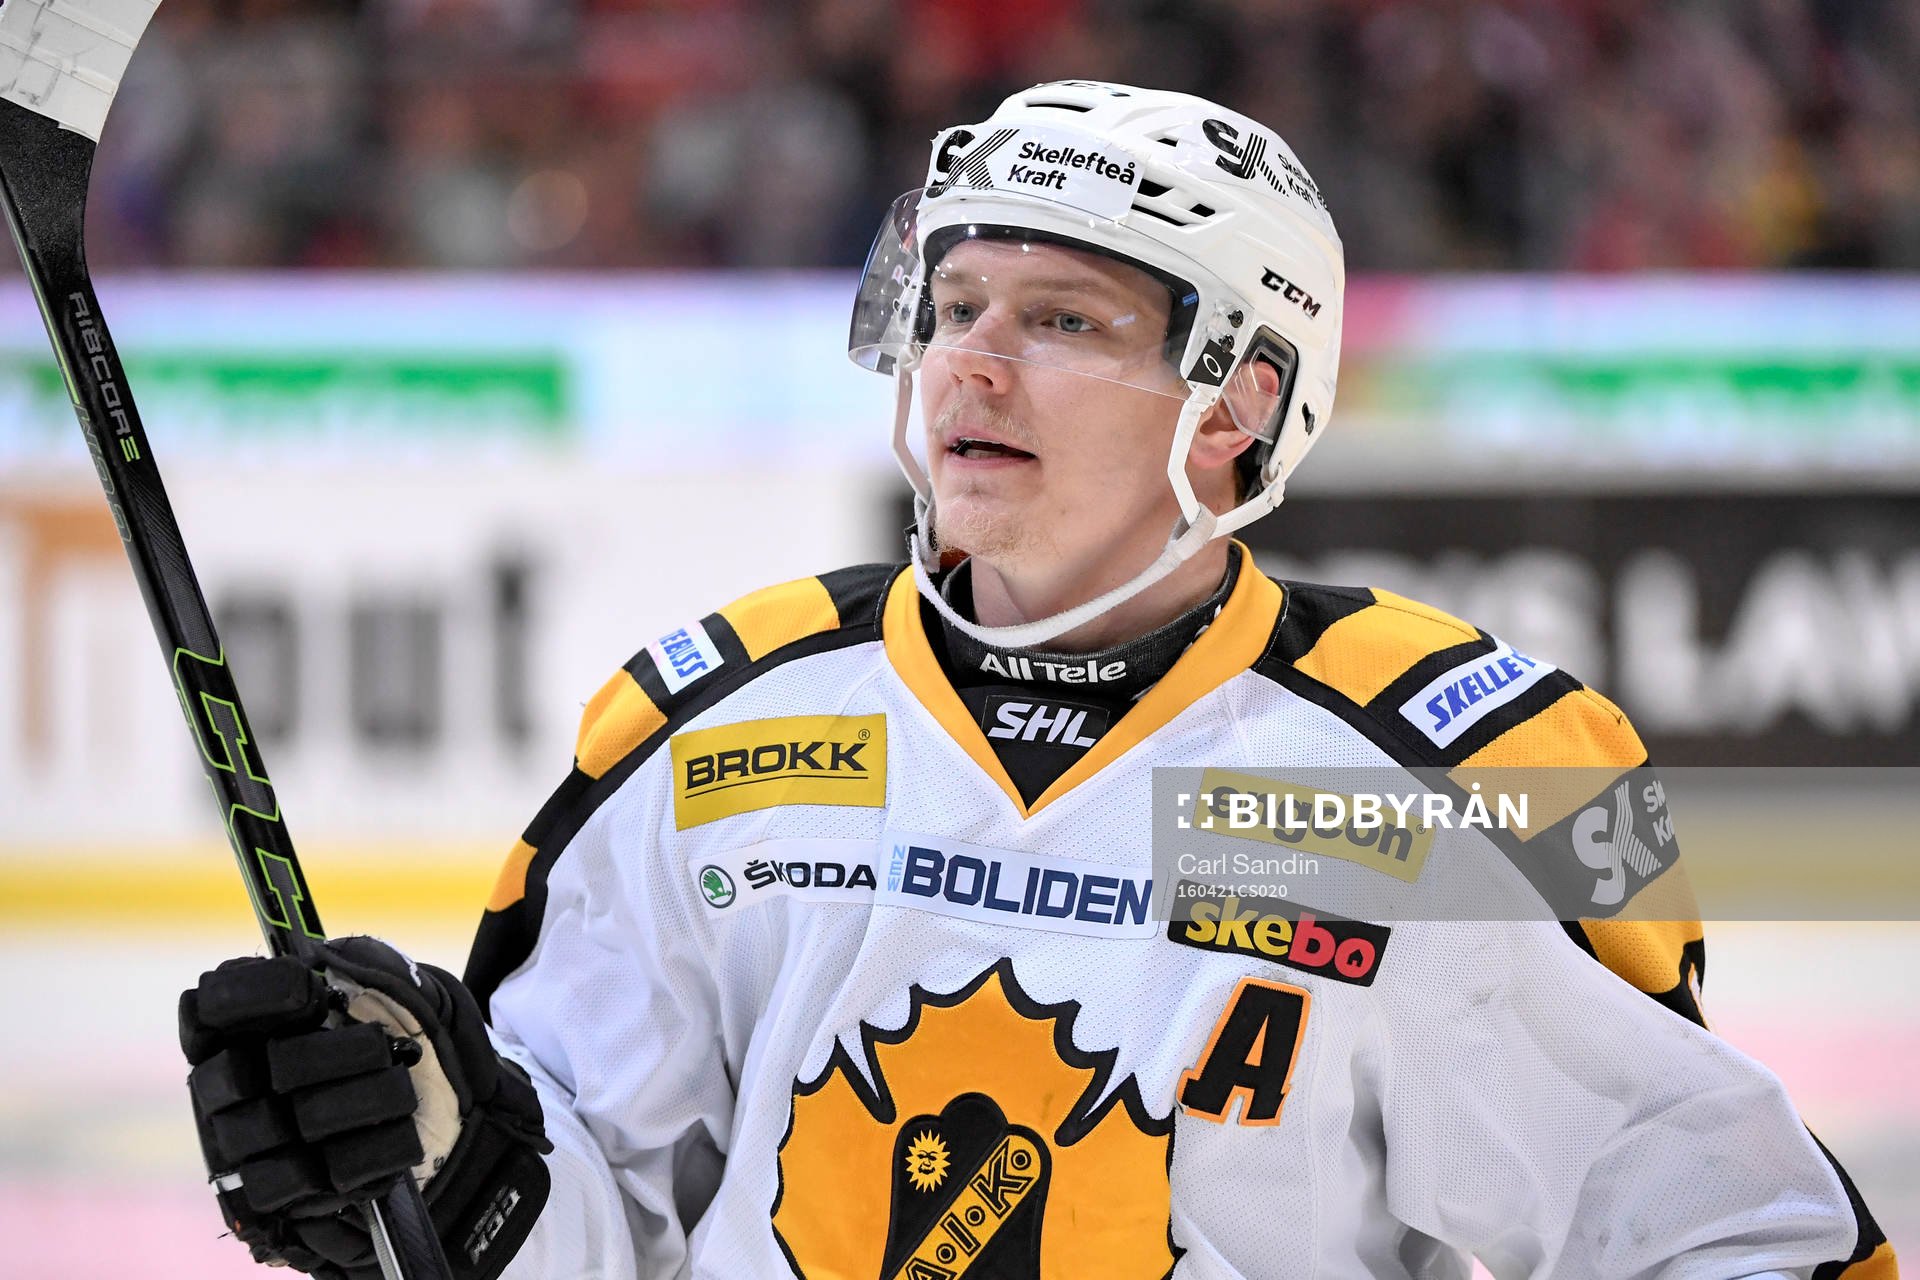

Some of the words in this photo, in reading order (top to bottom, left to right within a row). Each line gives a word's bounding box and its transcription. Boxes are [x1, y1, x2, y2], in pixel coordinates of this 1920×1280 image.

[1007, 164, 1067, 190] Kraft
[1018, 142, 1135, 186] Skellefteå
[1260, 265, 1322, 318] CCM
[987, 702, 1097, 748] SHL
[685, 741, 869, 790] BROKK
[743, 859, 877, 891] ŠKODA
[887, 844, 906, 893] NEW
[901, 846, 1154, 925] BOLIDEN
[1185, 896, 1376, 979] skebo
[1177, 977, 1312, 1126] A
